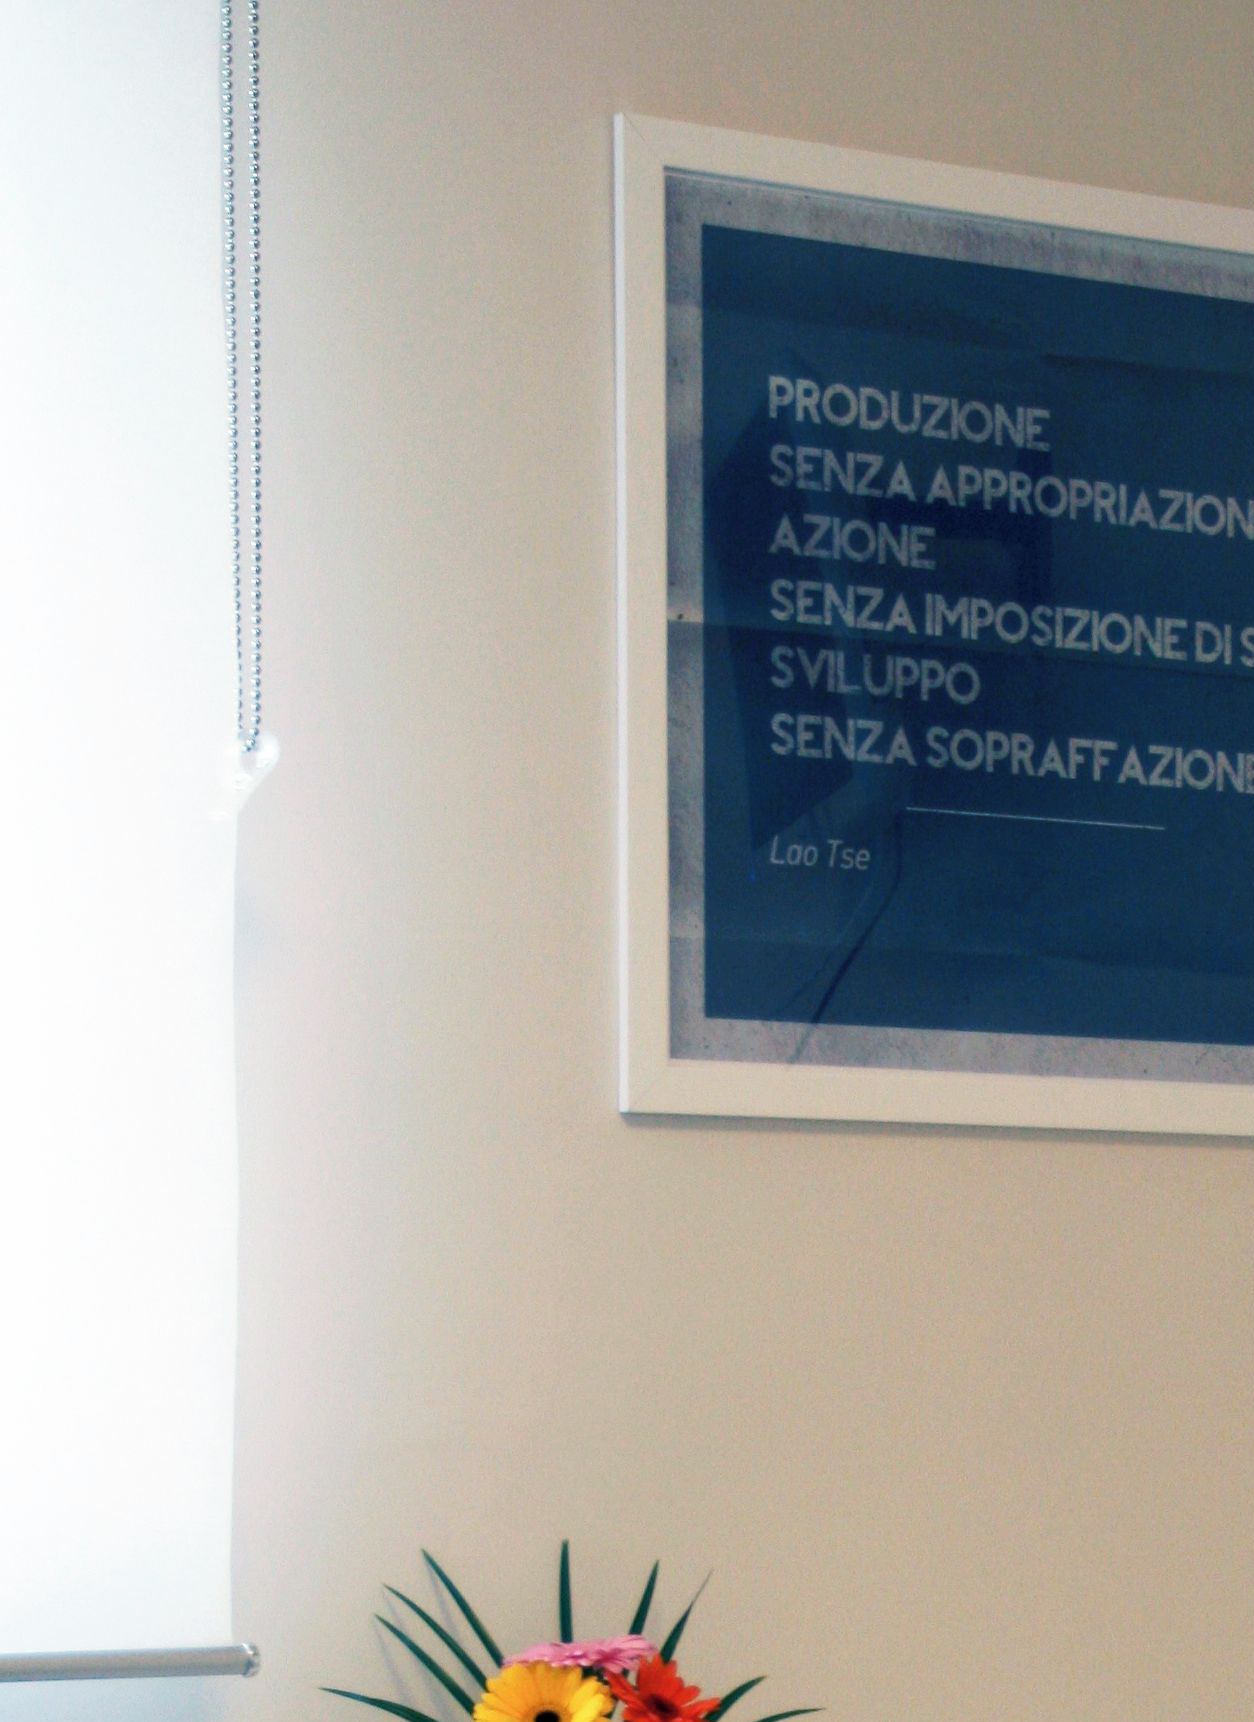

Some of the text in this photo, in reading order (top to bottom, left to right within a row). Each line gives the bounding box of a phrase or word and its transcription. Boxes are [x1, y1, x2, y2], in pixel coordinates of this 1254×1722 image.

[768, 375, 1051, 452] PRODUZIONE
[769, 445, 916, 501] SENZA
[768, 514, 936, 570] AZIONE
[769, 579, 916, 634] SENZA
[926, 594, 1187, 661] IMPOSIZIONE
[1194, 621, 1232, 666] DI
[770, 646, 981, 705] SVILUPPO
[770, 713, 916, 766] SENZA
[769, 835, 872, 871] Lao Tse
